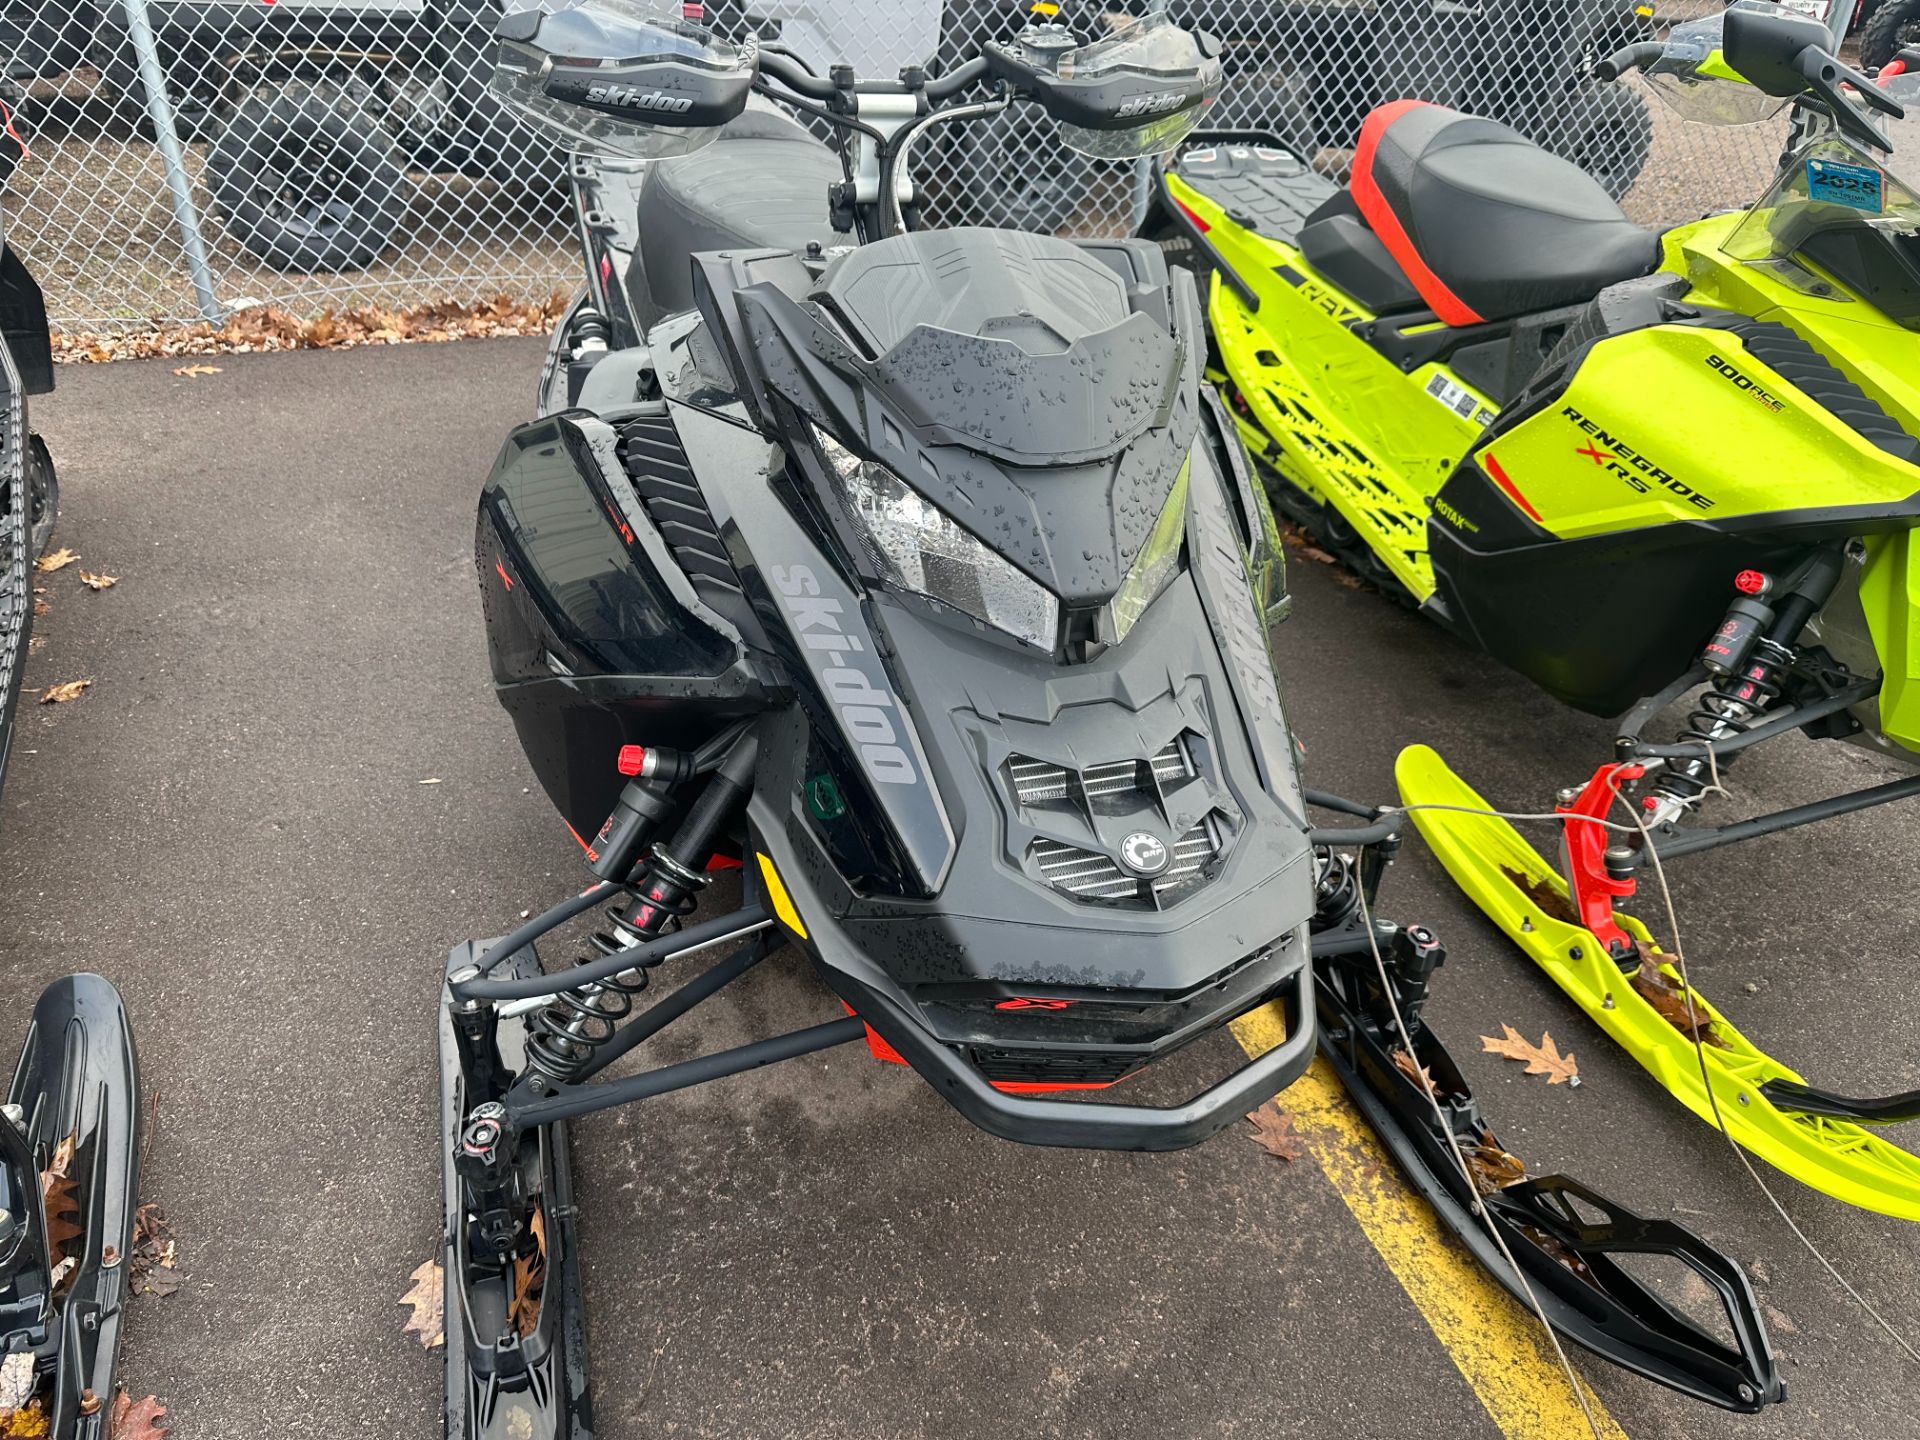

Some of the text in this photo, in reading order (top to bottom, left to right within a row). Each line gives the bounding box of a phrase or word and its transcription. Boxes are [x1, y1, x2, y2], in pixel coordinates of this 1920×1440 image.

[585, 86, 693, 113] ski-doo
[1561, 406, 1715, 510] RENEGADE
[1434, 497, 1465, 529] ROTAX
[771, 564, 917, 784] ski-doo
